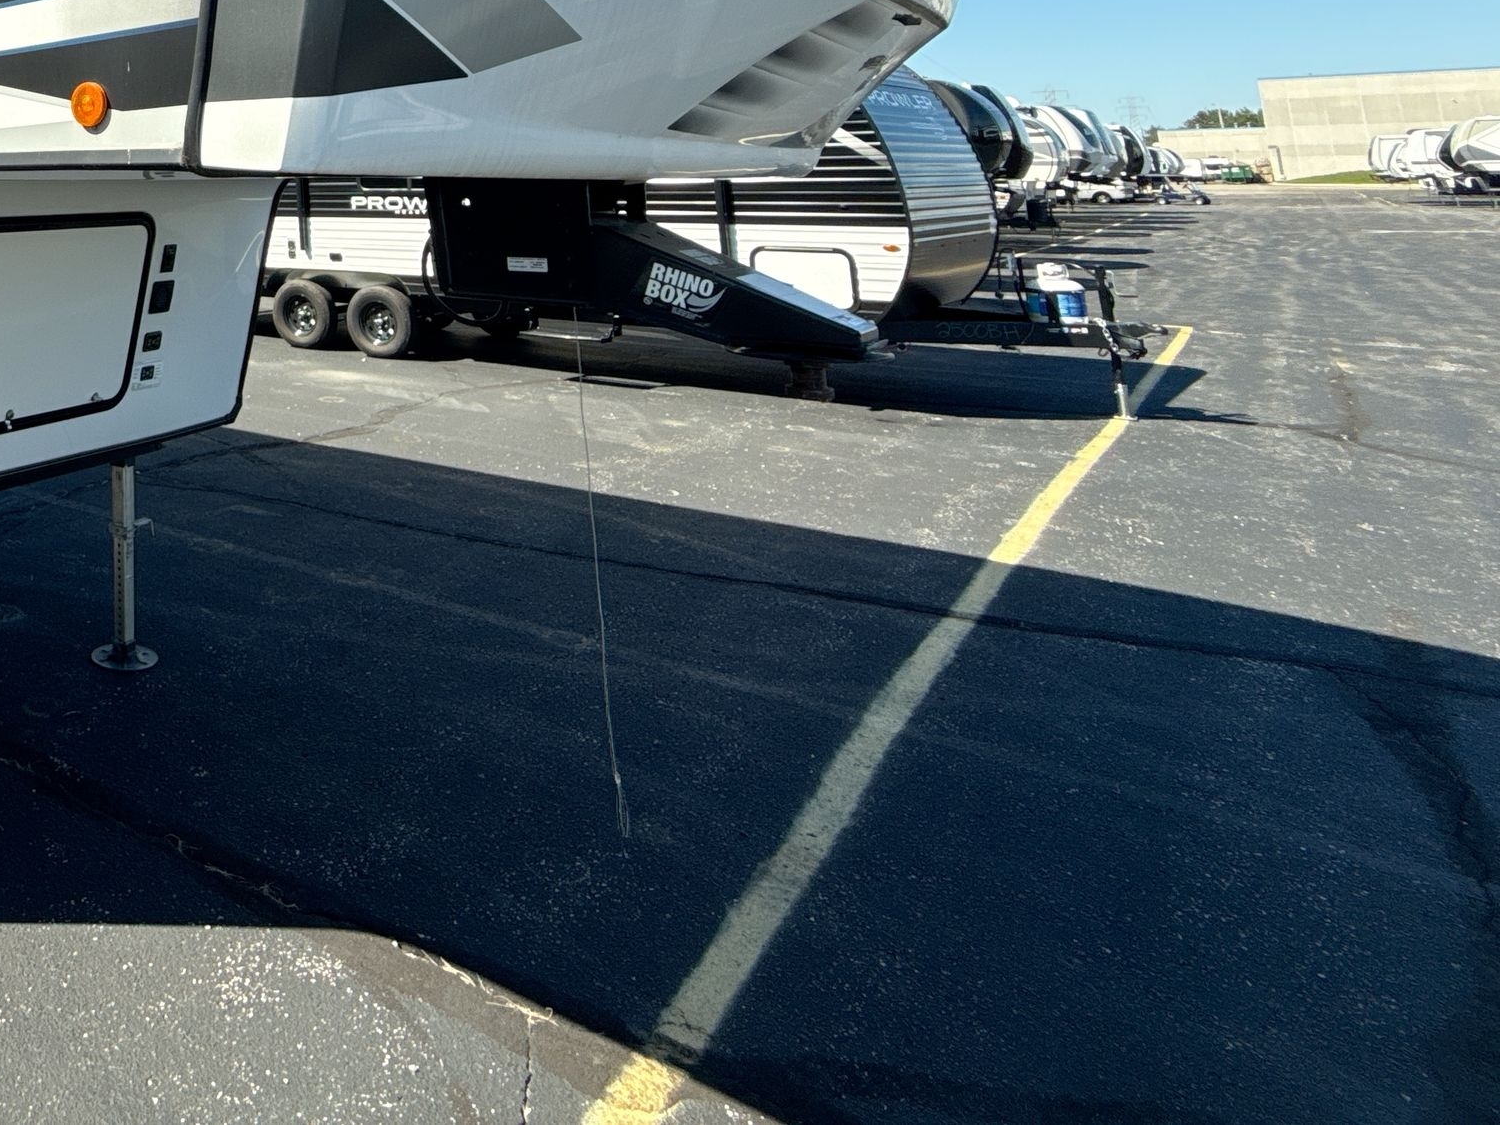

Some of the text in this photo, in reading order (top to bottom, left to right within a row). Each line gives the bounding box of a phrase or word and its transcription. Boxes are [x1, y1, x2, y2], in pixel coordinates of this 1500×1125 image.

[866, 89, 937, 111] PROWLER
[644, 278, 690, 309] BOX
[650, 262, 714, 297] RHINO
